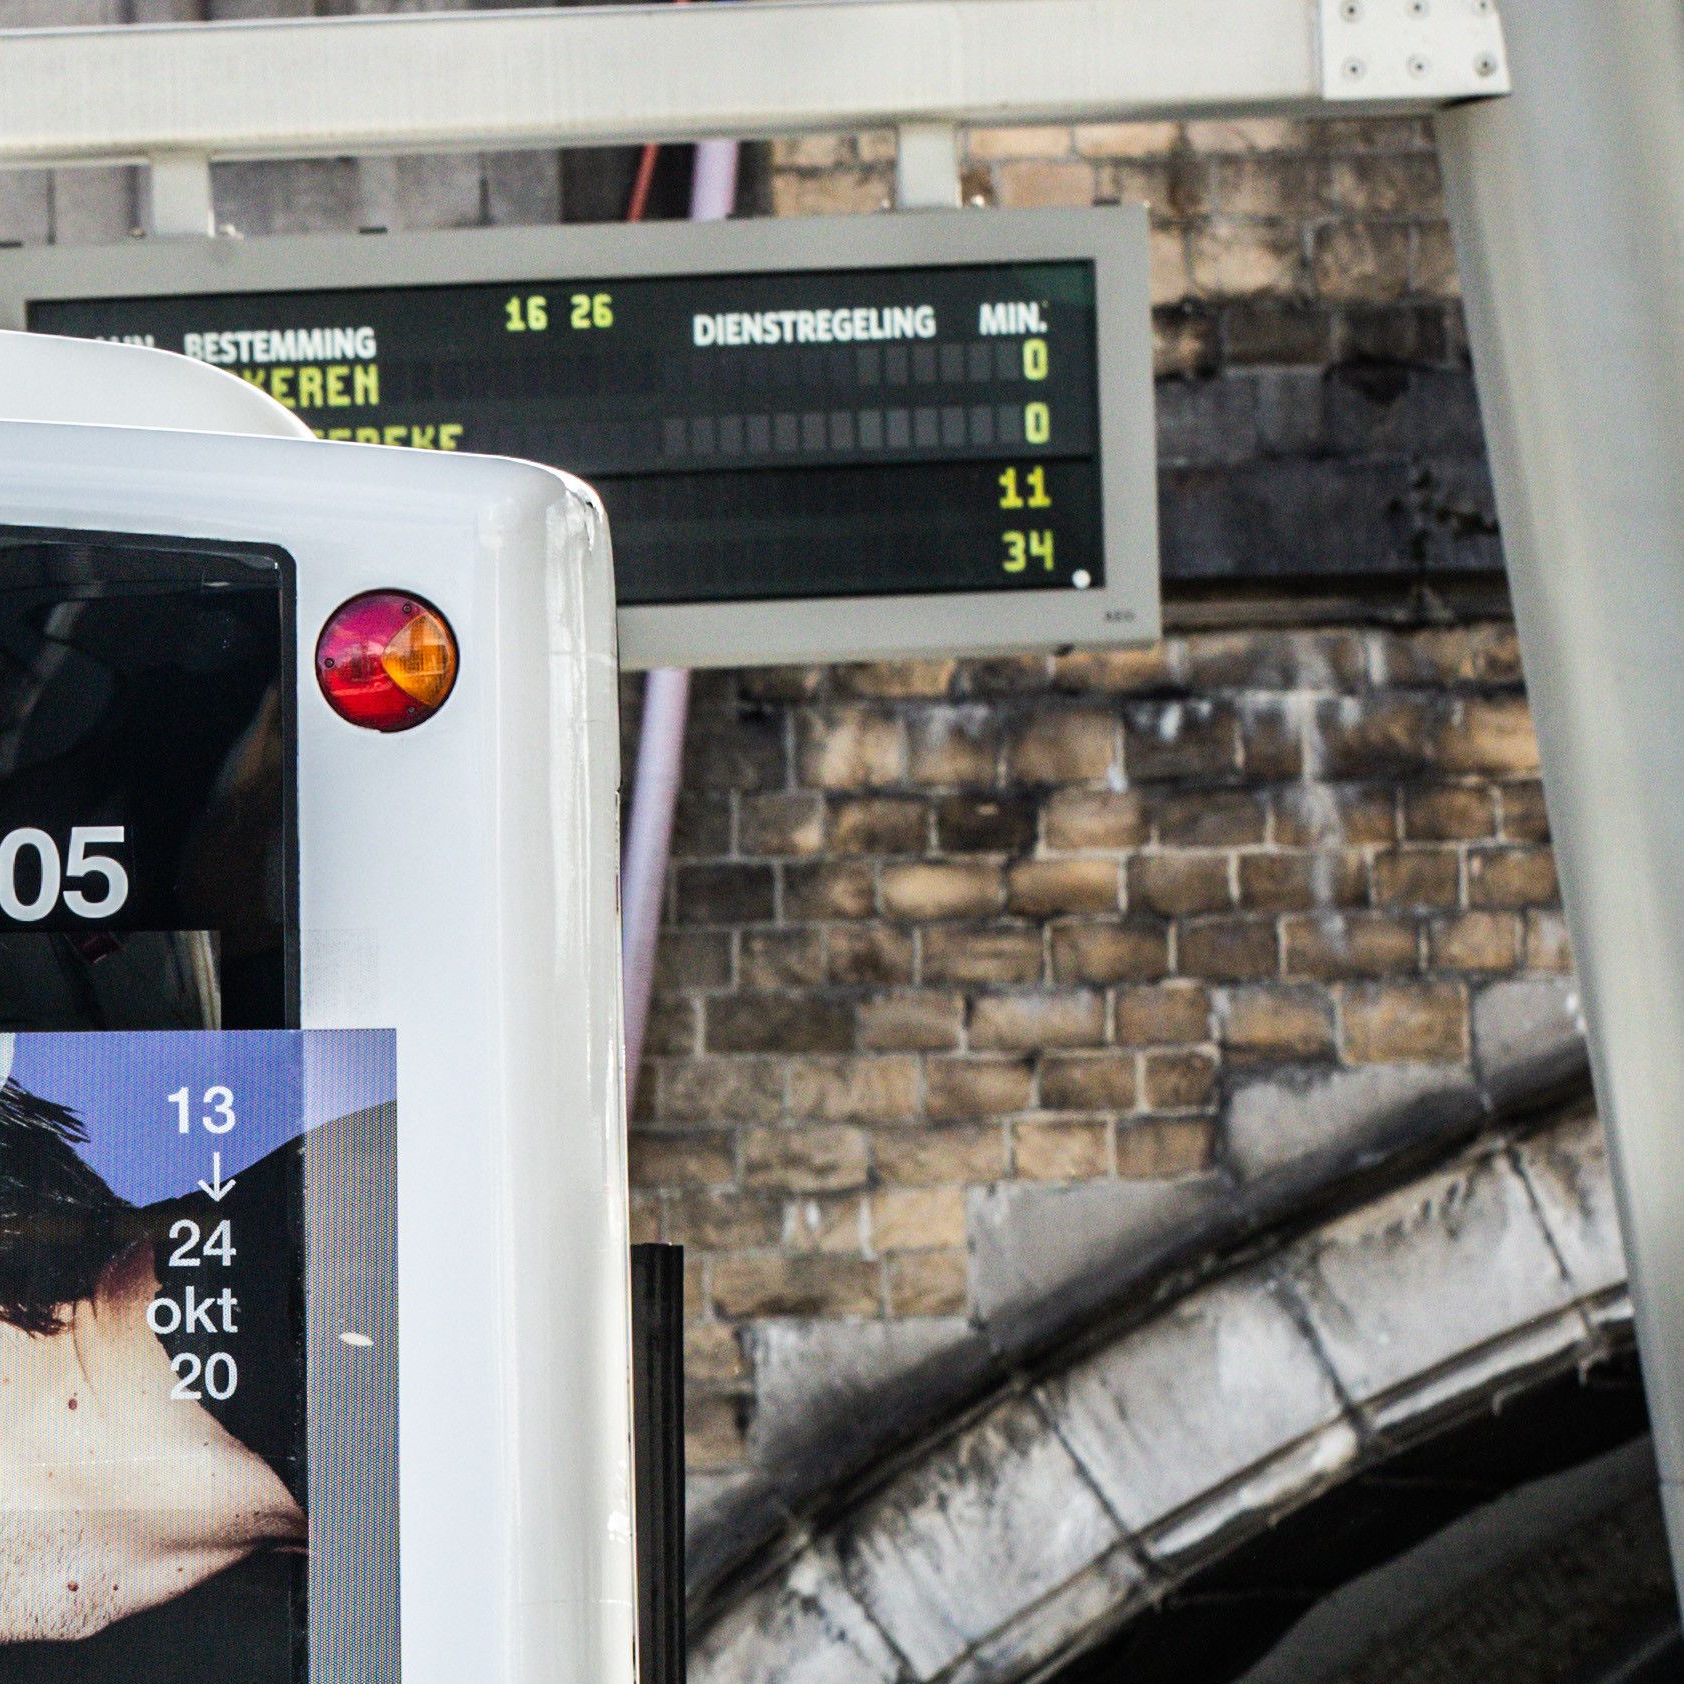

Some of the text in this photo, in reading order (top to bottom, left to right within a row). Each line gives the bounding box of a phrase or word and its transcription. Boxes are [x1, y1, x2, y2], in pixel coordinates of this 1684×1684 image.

[184, 301, 1048, 364] BESTEMMING DIENSTREGELING MIN.
[1022, 338, 1049, 381] 0
[1024, 402, 1050, 445] 0
[999, 466, 1052, 510] 11
[1001, 529, 1054, 573] 34
[167, 1086, 236, 1135] 13
[167, 1219, 237, 1268] 24
[145, 1286, 238, 1334] okt
[169, 1352, 238, 1401] 20
